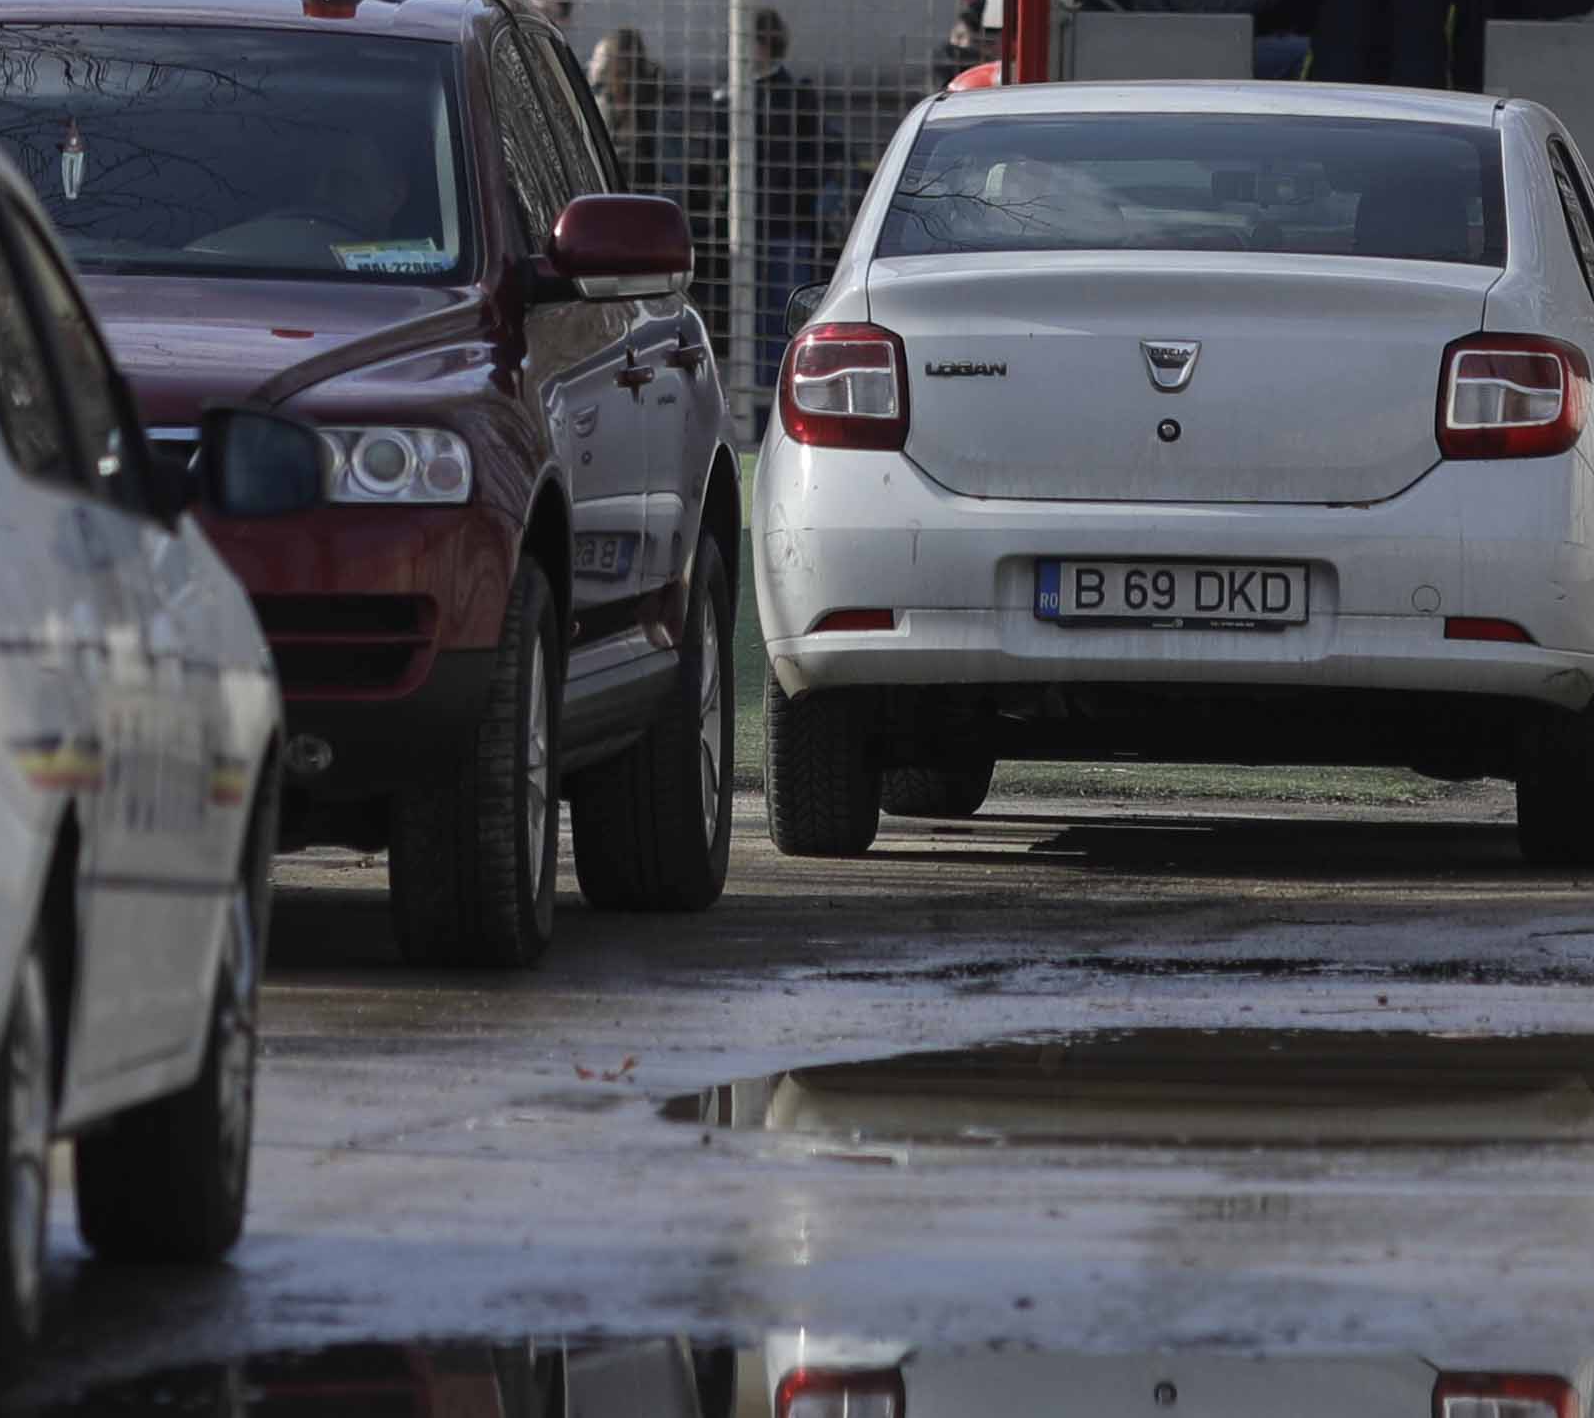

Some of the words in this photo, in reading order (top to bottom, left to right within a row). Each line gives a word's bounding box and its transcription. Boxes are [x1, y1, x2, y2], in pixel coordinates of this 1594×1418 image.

[925, 362, 1007, 377] LOGAN
[1075, 568, 1105, 610] B
[1123, 569, 1176, 611] 69
[1194, 570, 1292, 614] DKD
[1039, 592, 1059, 610] RO
